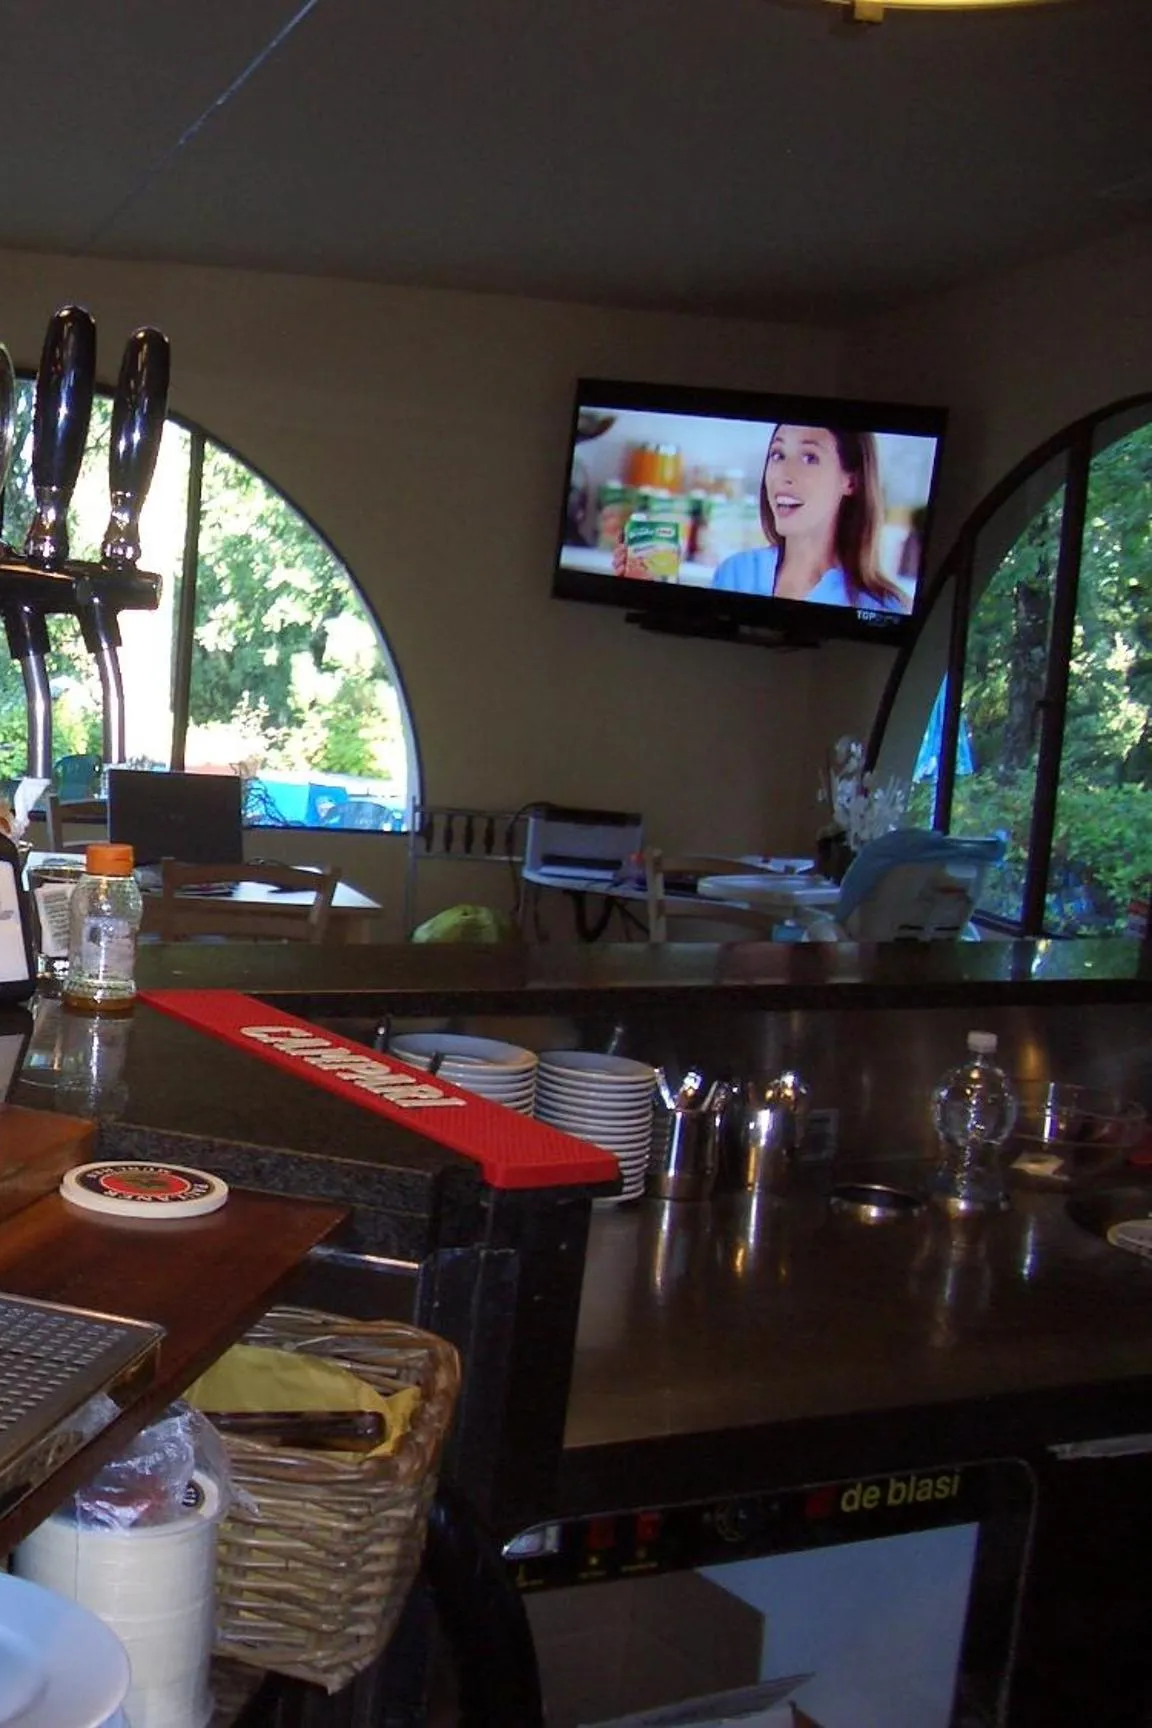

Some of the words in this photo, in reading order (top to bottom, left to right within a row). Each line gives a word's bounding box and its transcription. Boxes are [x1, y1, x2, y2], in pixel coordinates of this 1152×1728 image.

[239, 1025, 468, 1108] CAMPARI
[840, 1481, 881, 1513] de
[887, 1470, 961, 1507] blasi
